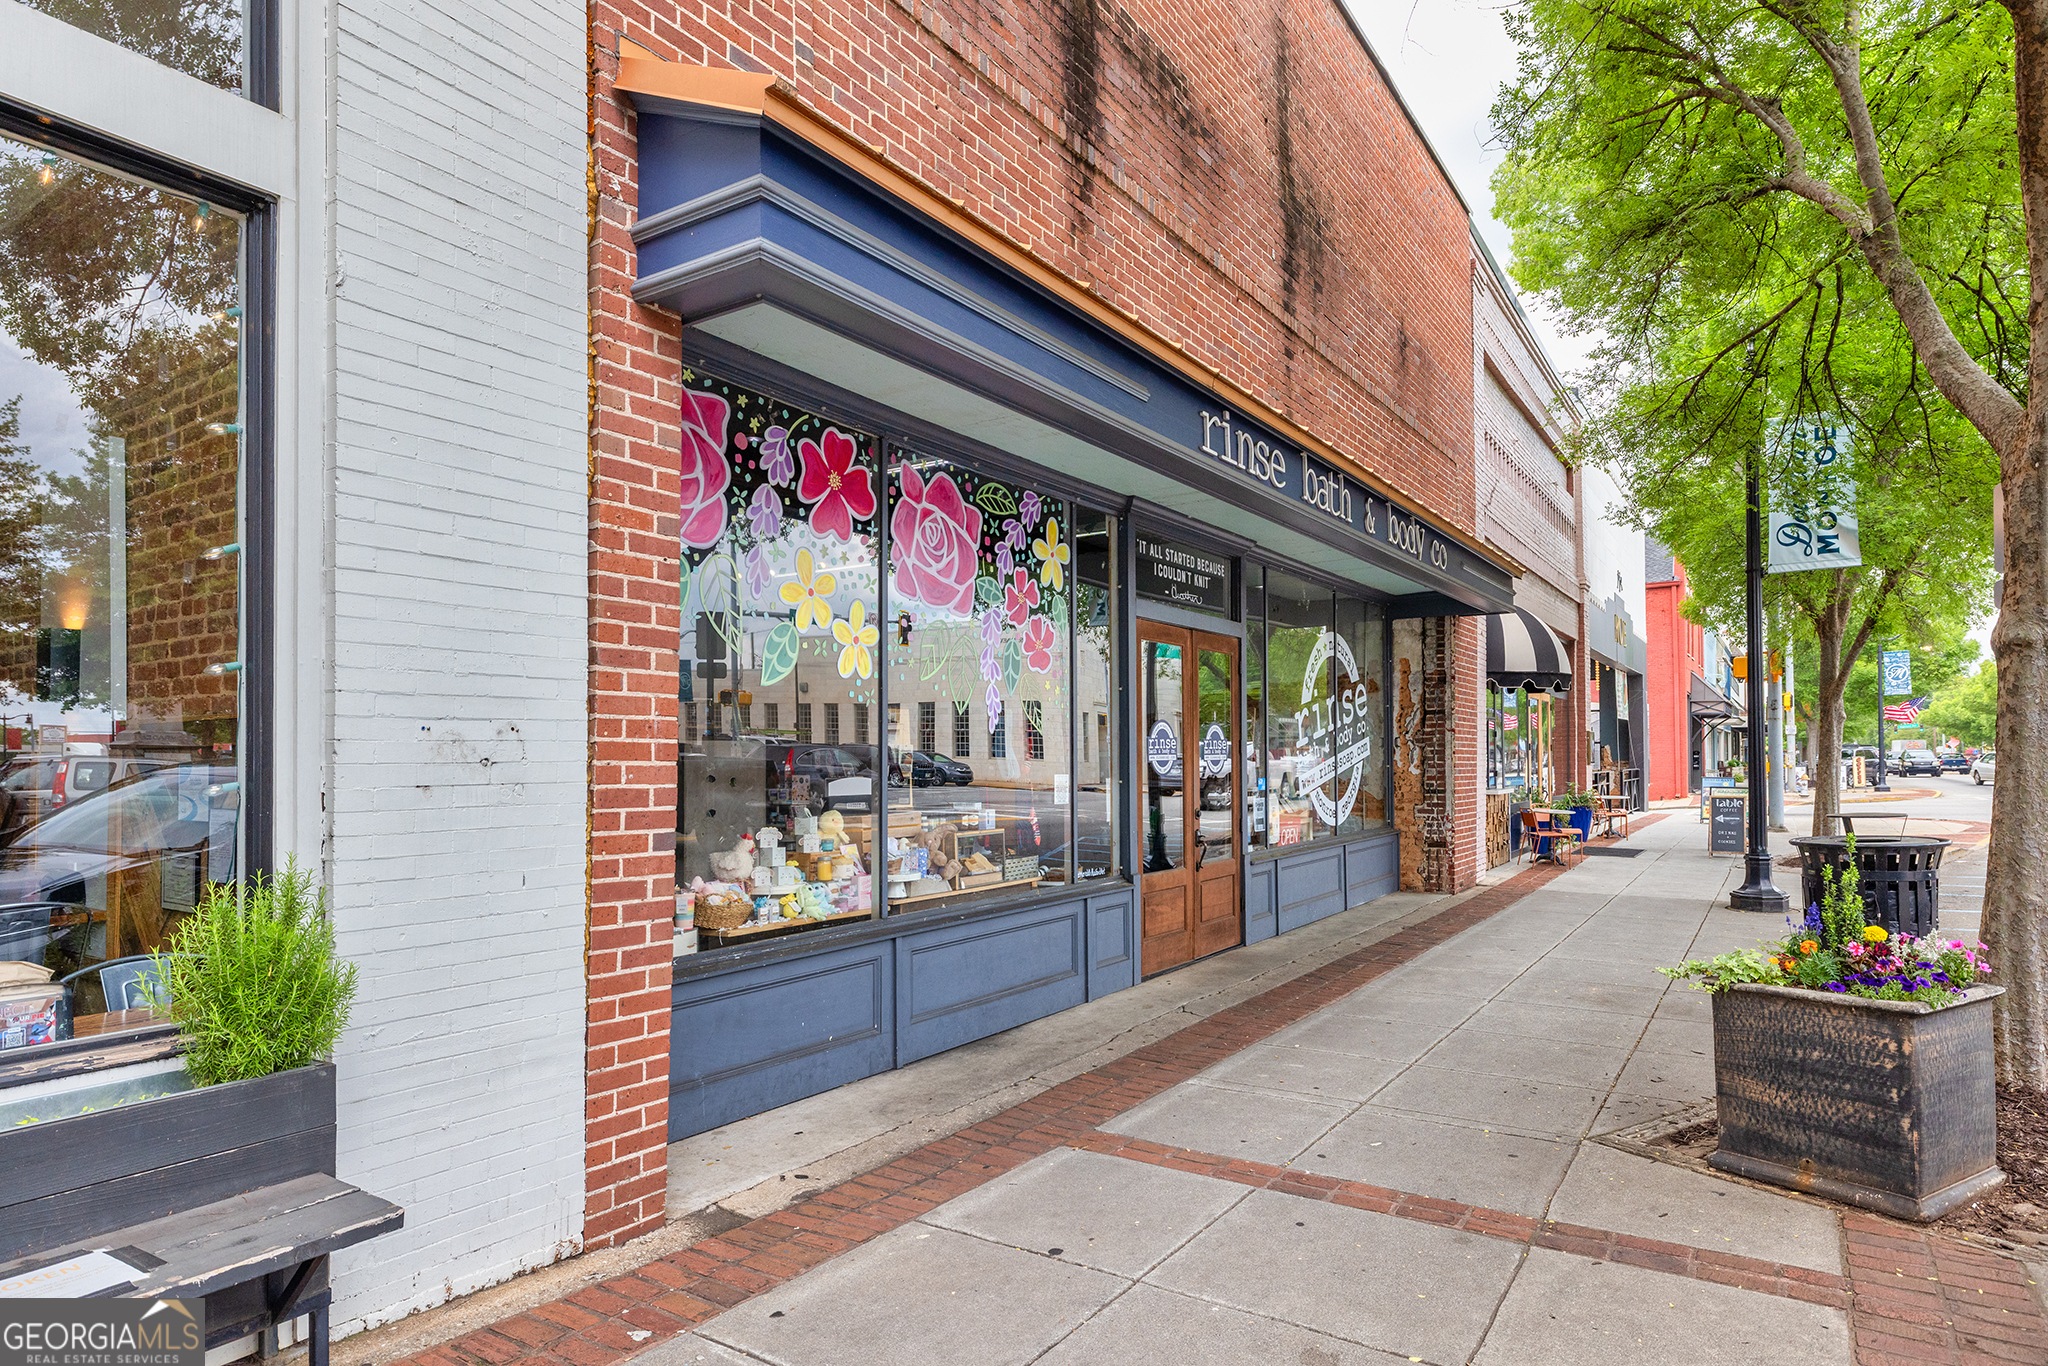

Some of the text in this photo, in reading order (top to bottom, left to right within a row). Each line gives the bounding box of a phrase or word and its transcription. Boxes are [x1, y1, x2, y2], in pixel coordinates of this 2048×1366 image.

[1199, 410, 1286, 488] rinse
[1300, 451, 1353, 523] bath
[1364, 497, 1376, 534] &
[1386, 502, 1425, 560] body
[1149, 543, 1163, 559] ALL
[1165, 548, 1195, 569] STARTED
[1196, 557, 1225, 577] BECAUSE
[1153, 562, 1157, 576] I
[1158, 563, 1192, 585] COULDN'T
[1304, 640, 1354, 693] fresh ntural
[1294, 683, 1368, 748] rinse
[1148, 735, 1177, 749] rinse
[1203, 737, 1227, 749] rinse
[1324, 737, 1330, 753] &
[1356, 720, 1369, 735] co.
[1300, 741, 1369, 790] www.rinssoap.com
[1280, 827, 1299, 846] OPEN
[0, 1263, 82, 1292] OKEN
